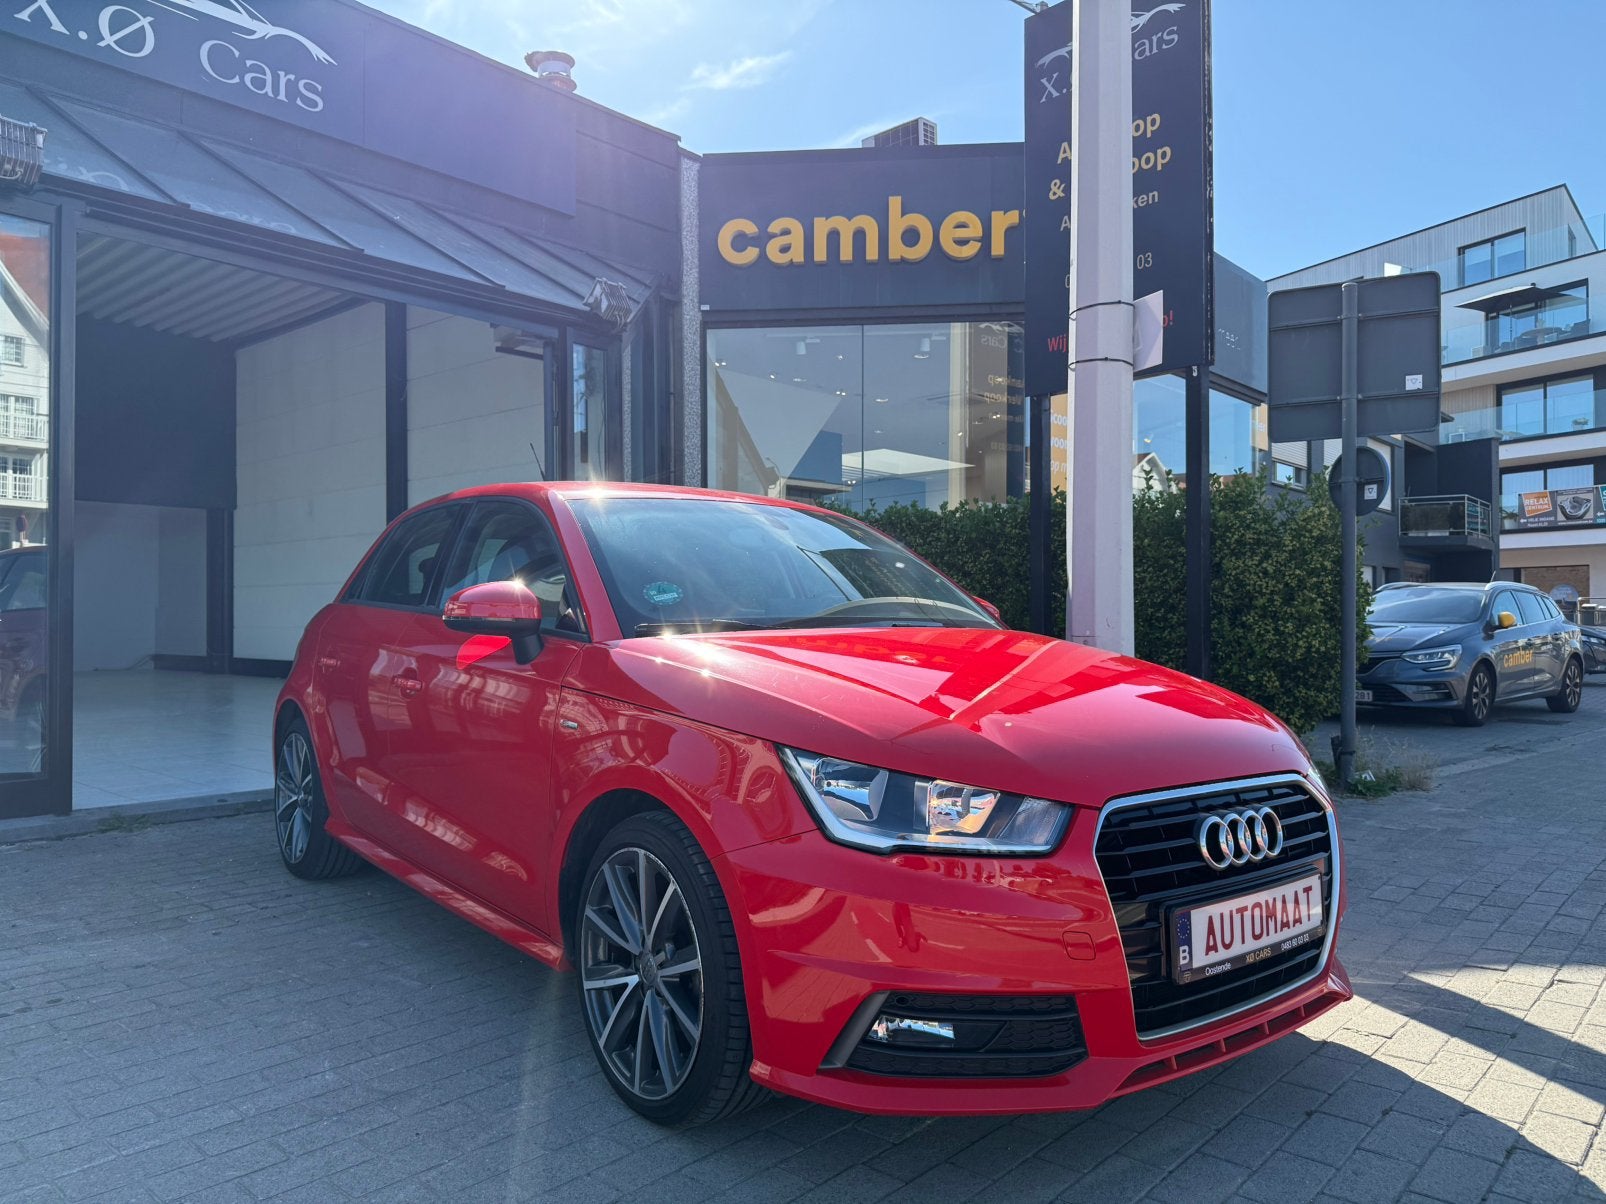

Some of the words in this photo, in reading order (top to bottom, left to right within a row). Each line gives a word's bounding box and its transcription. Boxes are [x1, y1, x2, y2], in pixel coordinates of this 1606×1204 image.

[1040, 72, 1072, 103] X.
[1133, 26, 1179, 60] ars
[199, 39, 324, 112] Cars
[1048, 179, 1066, 200] &
[717, 195, 1020, 267] camber
[1136, 252, 1153, 270] 03
[1048, 334, 1069, 352] Wij
[1524, 497, 1549, 507] RELAX
[1503, 648, 1534, 668] camber
[1204, 885, 1313, 956] AUTOMAAT
[1180, 945, 1190, 965] B
[1205, 962, 1232, 976] Oostende
[1255, 947, 1272, 960] CARS
